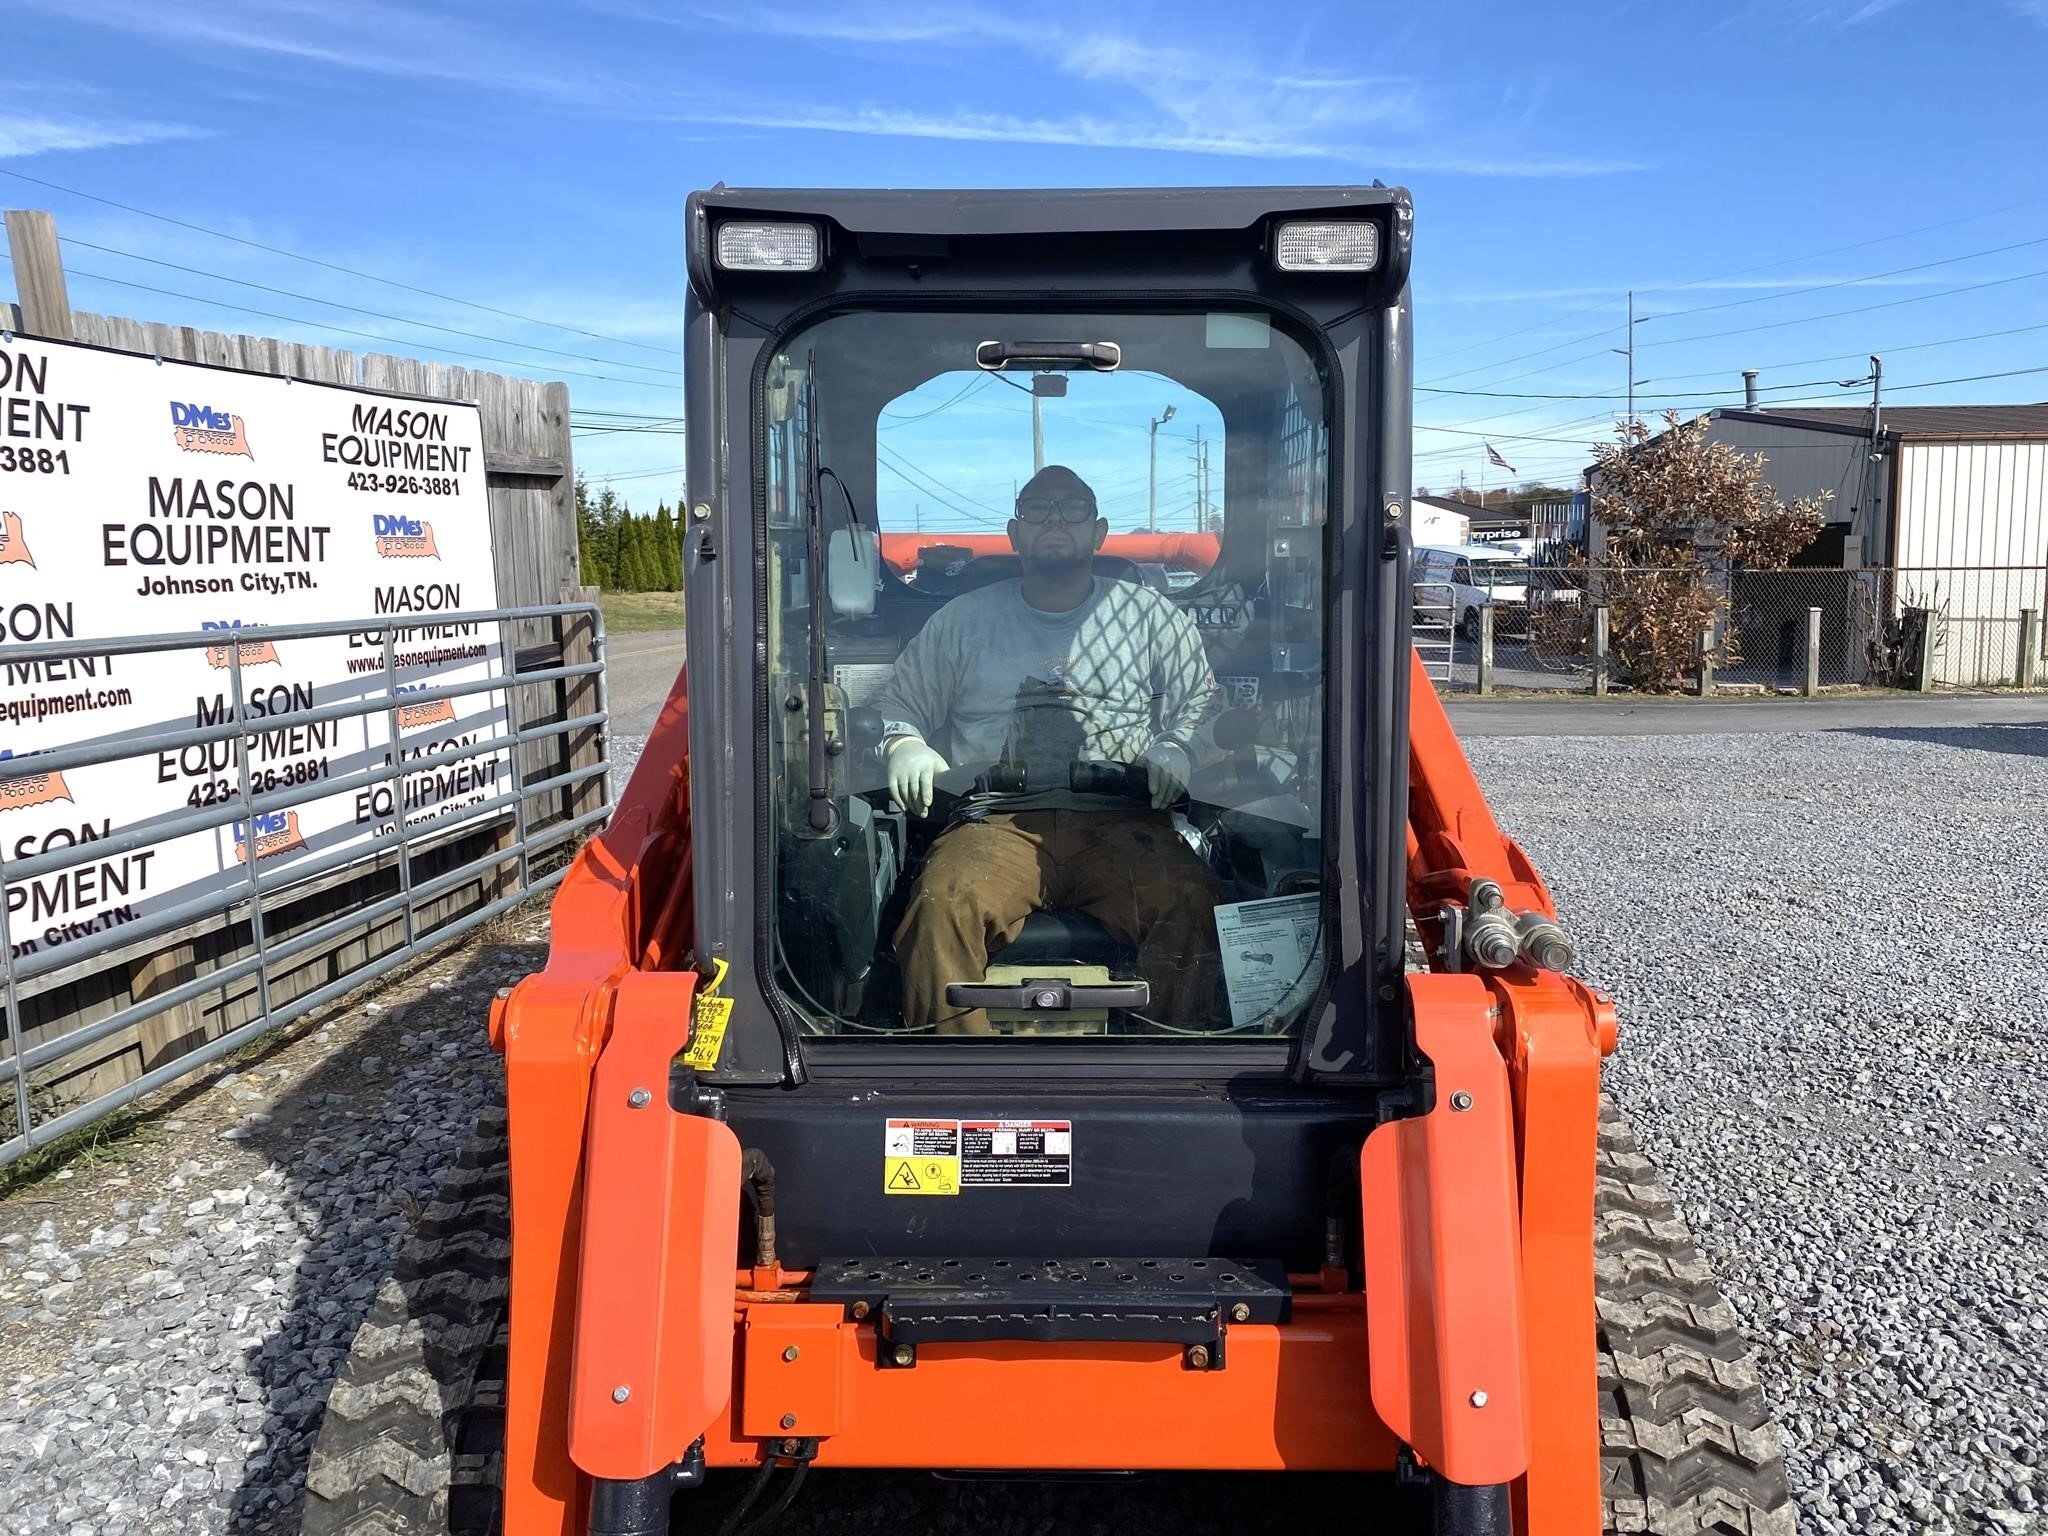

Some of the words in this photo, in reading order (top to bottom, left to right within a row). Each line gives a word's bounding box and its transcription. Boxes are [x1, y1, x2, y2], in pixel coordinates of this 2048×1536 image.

[0, 397, 90, 441] ENT
[352, 404, 447, 441] MASON
[322, 433, 471, 472] EQUIPMENT
[149, 477, 294, 520] MASON
[347, 472, 460, 496] 423-926-3881
[103, 523, 331, 566] EQUIPMENT
[137, 575, 233, 596] Johnson
[375, 583, 460, 614] MASON
[347, 643, 487, 673] www.dasonequipment.com
[187, 757, 329, 808] 423-26-3881
